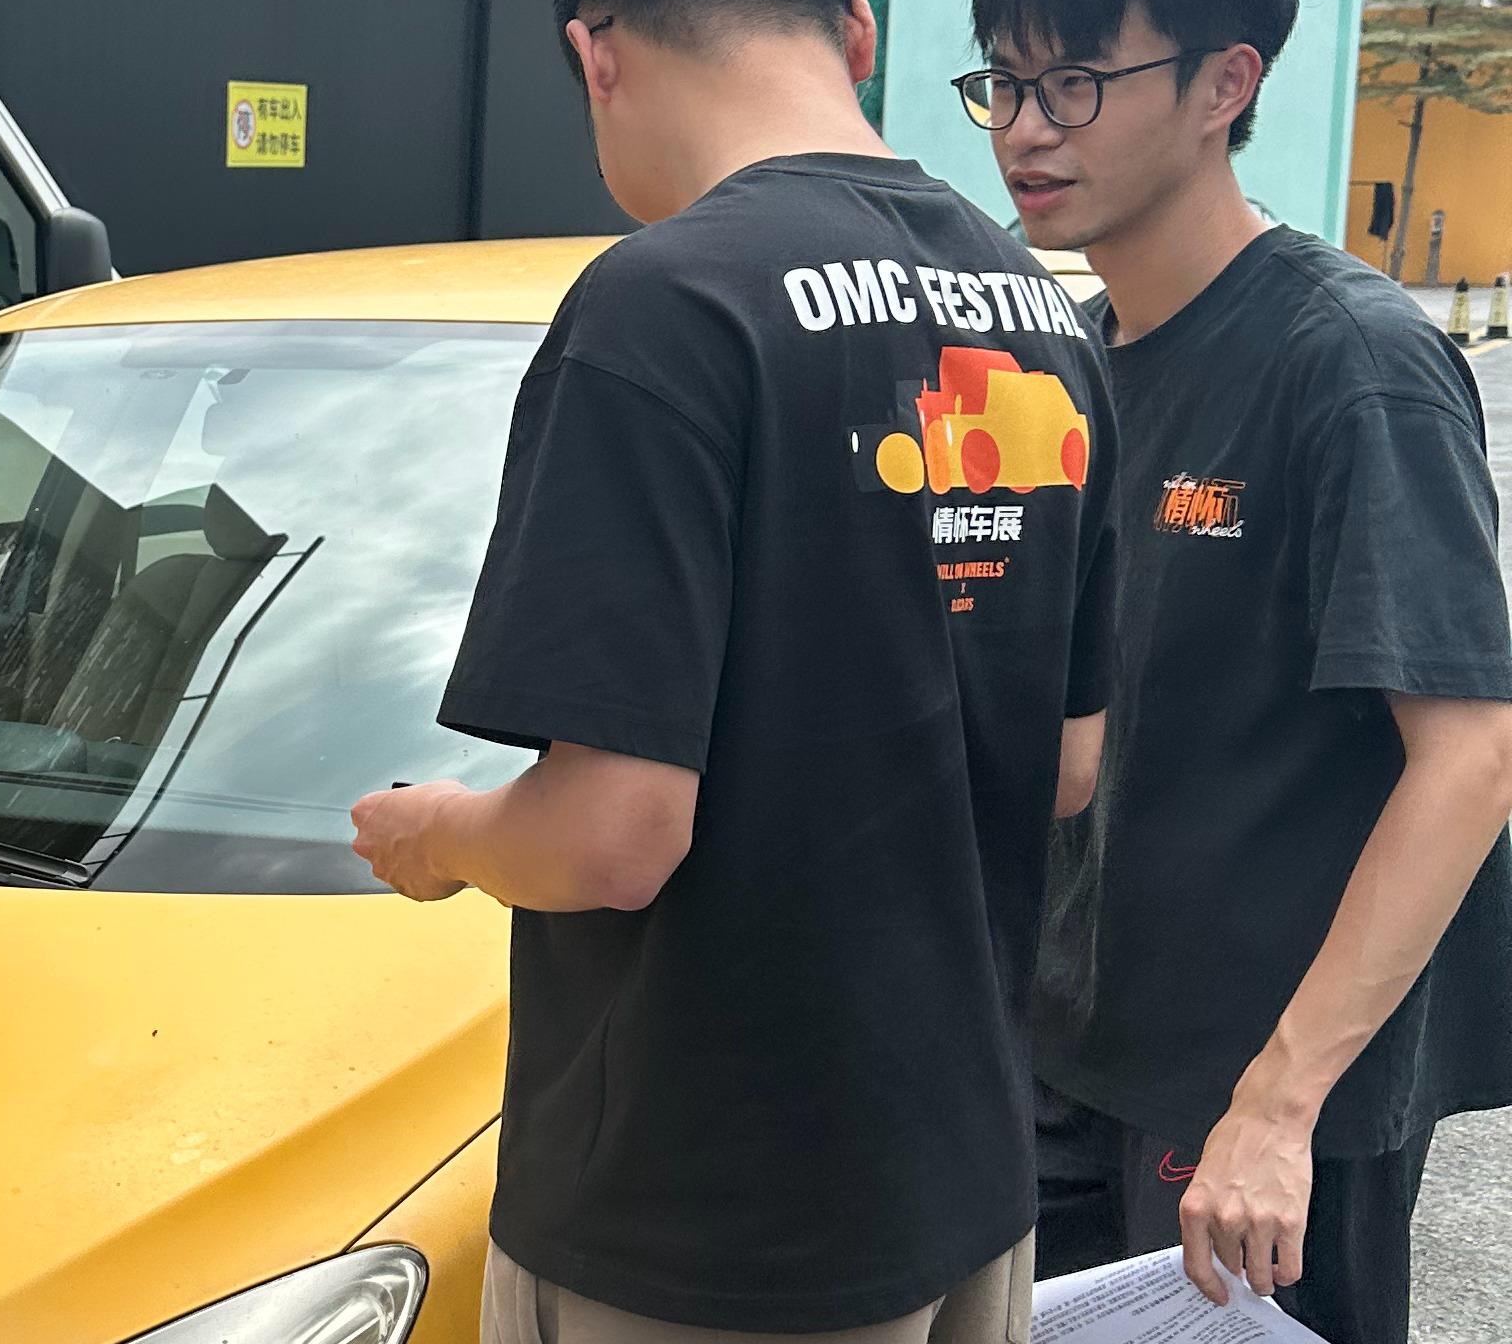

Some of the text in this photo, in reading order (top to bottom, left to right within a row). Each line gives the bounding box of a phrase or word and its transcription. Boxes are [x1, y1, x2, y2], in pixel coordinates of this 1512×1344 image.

[257, 98, 302, 120] 有车出入
[783, 258, 1088, 340] OMC FESTIVAL
[932, 505, 1024, 544] 情怀车展
[963, 561, 1005, 578] WHEELS
